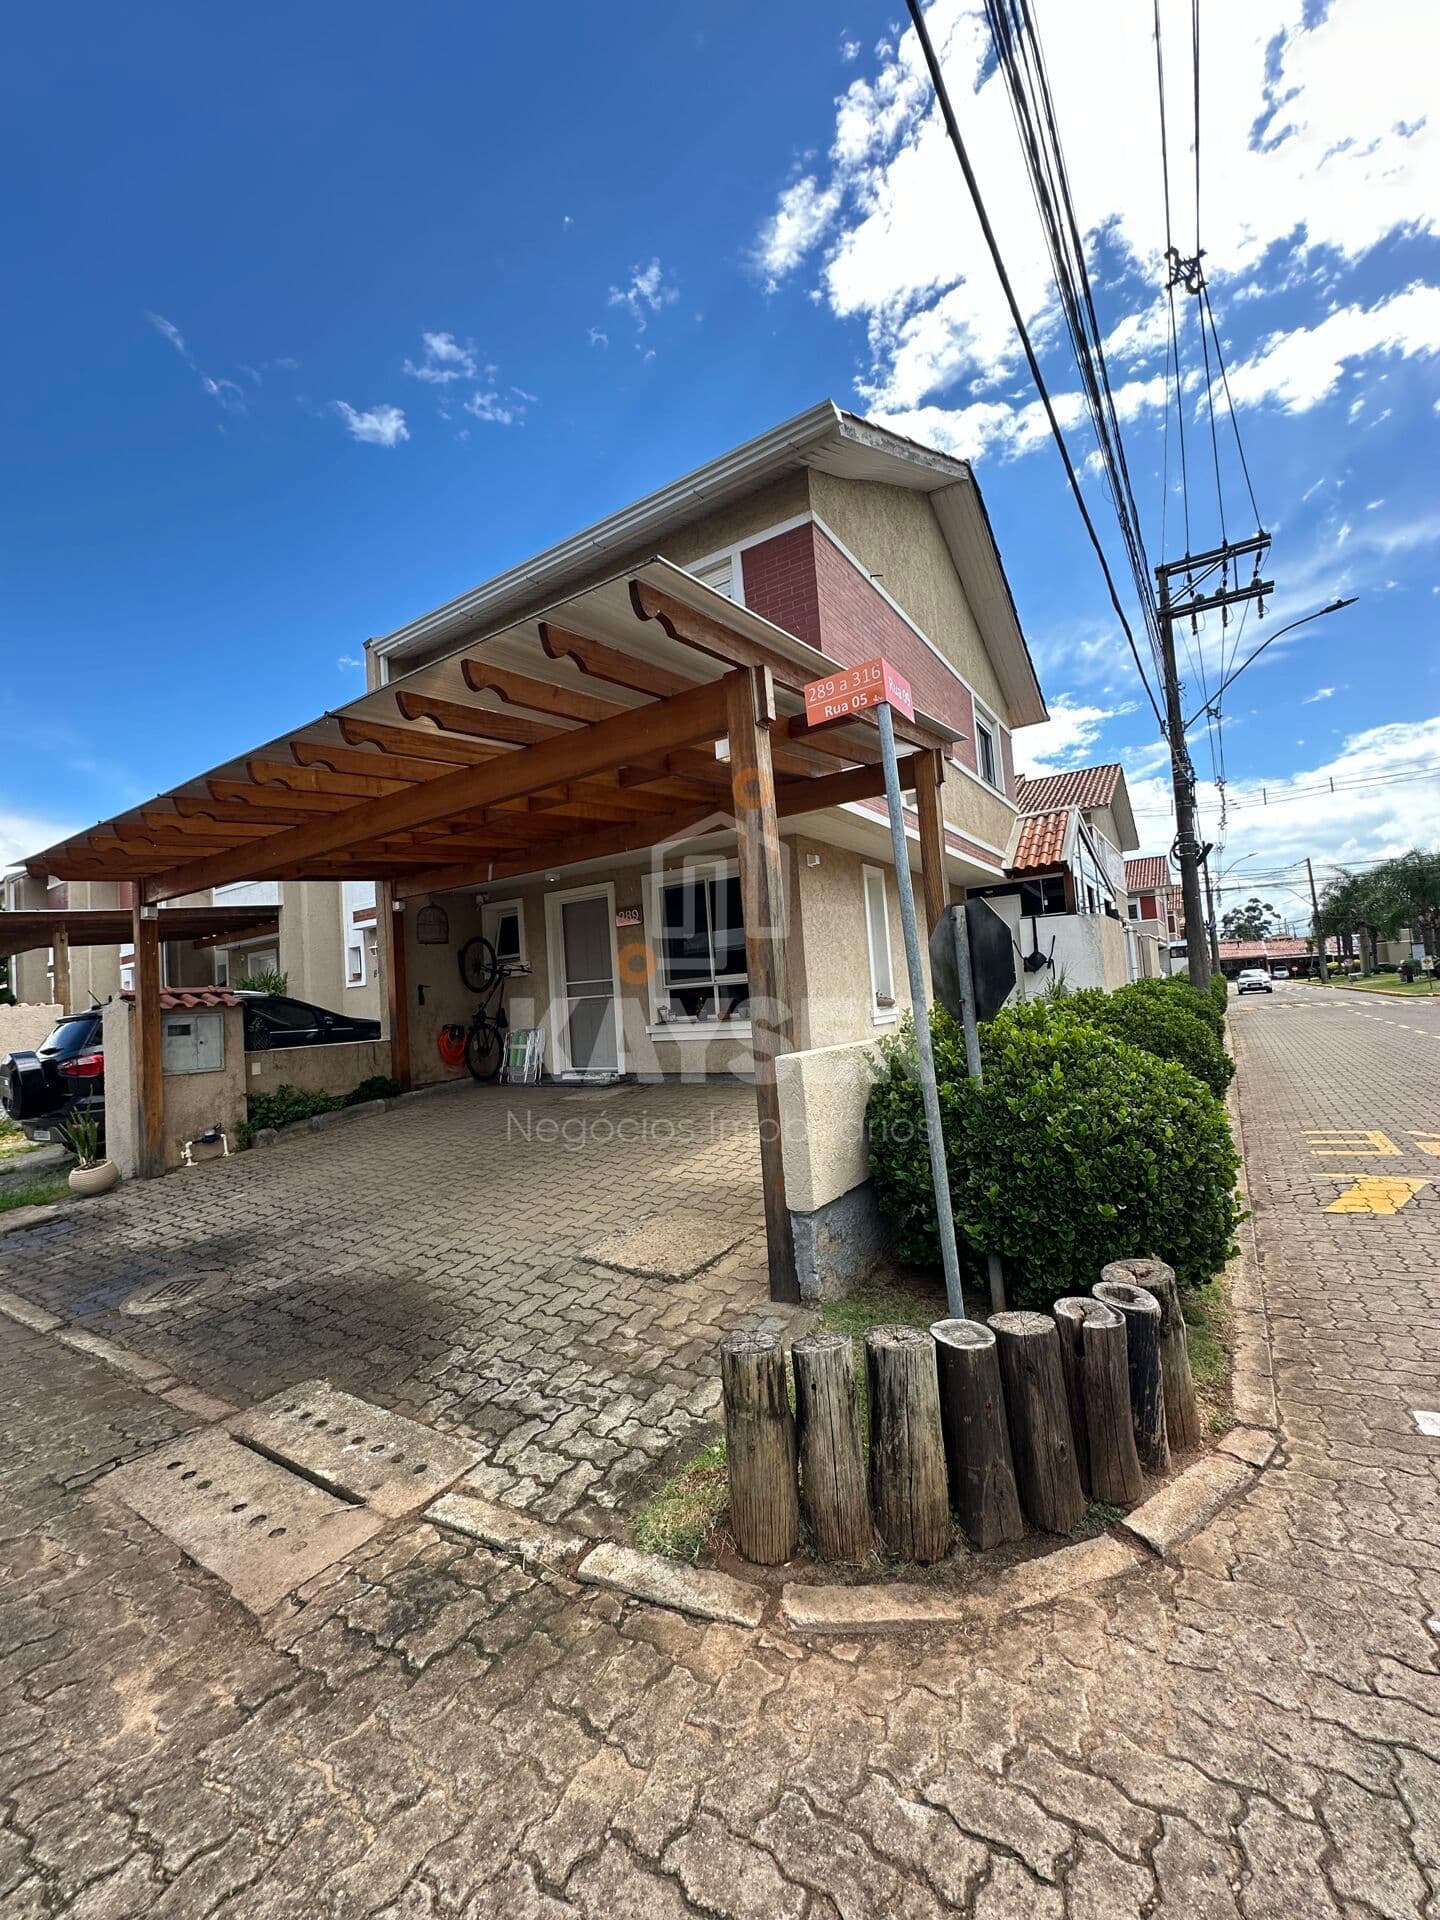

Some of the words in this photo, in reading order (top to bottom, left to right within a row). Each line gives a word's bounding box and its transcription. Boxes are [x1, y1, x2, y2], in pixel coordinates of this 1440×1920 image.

[808, 681, 835, 702] 289
[839, 682, 848, 691] a
[852, 664, 881, 687] 316
[824, 702, 849, 717] Rua
[851, 693, 868, 708] 05
